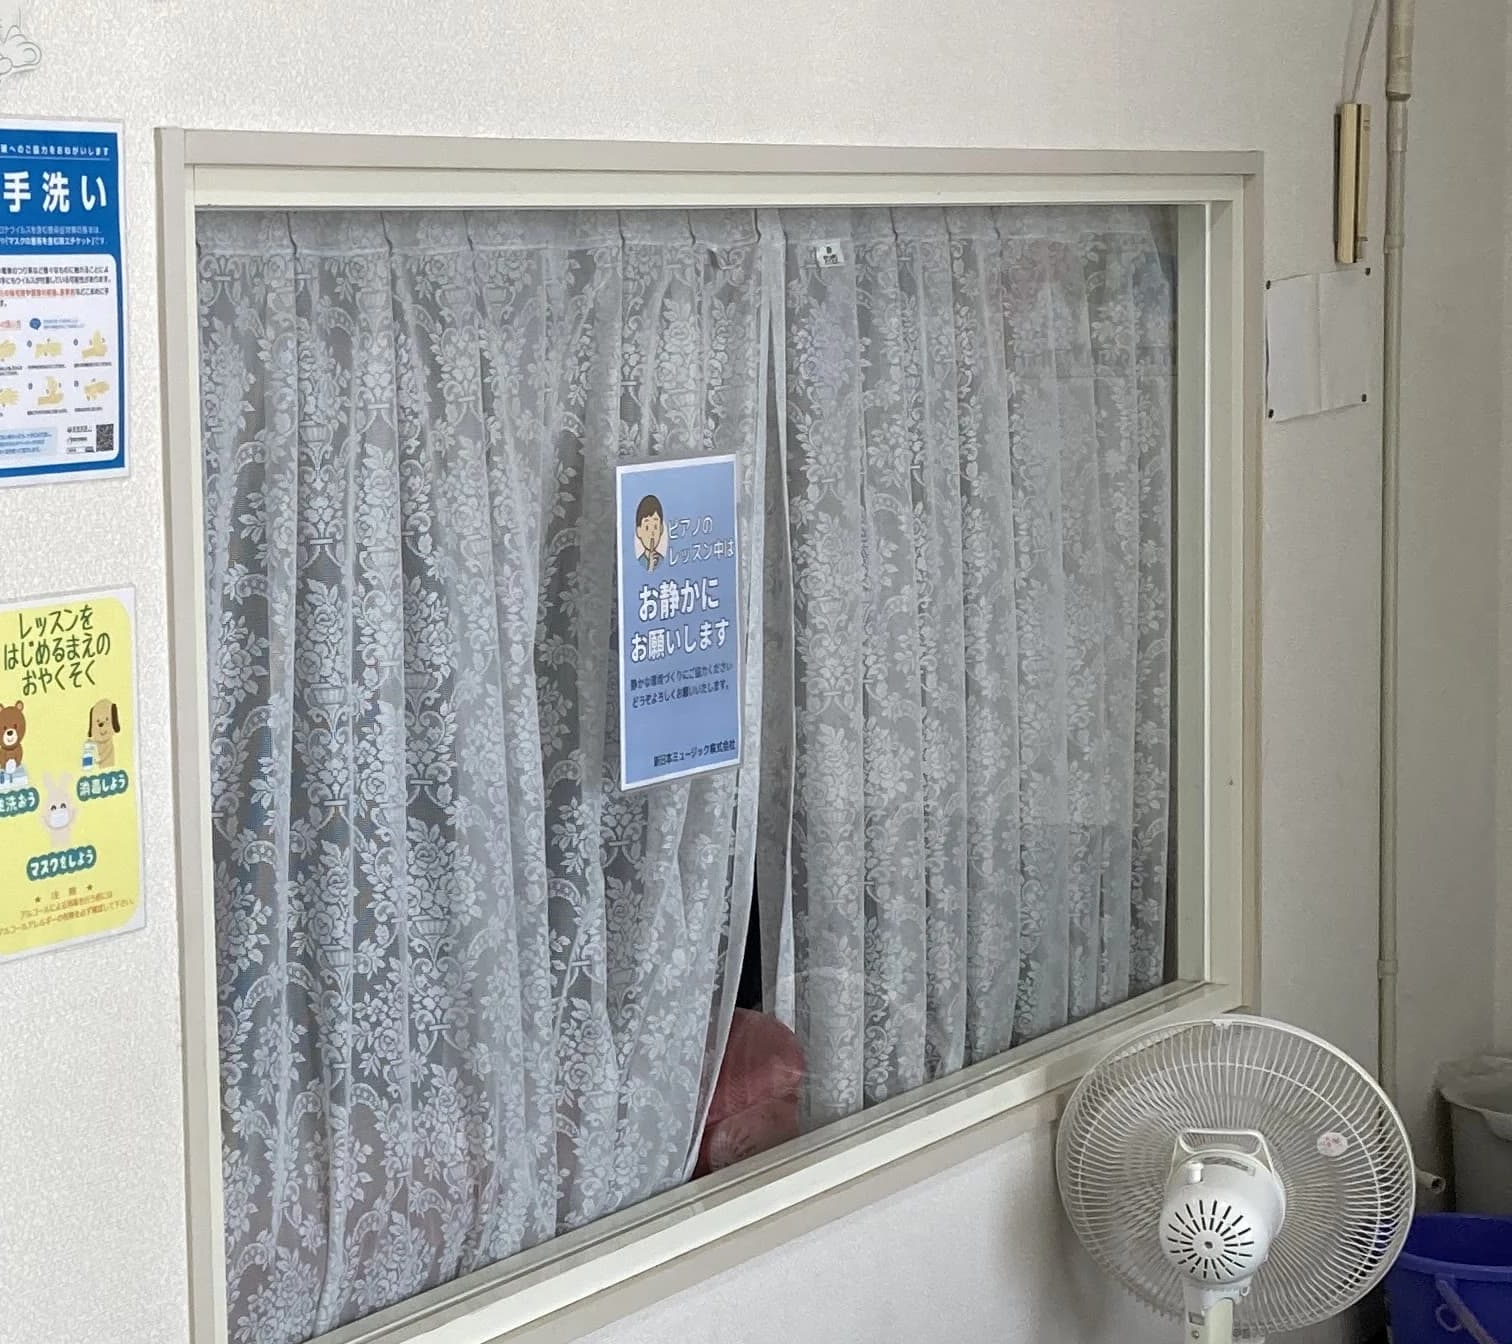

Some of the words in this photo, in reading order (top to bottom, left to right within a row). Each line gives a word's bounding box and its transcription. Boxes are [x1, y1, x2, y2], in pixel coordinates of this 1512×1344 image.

[3, 170, 108, 213] 手洗い
[669, 517, 713, 540] ピアノの
[669, 538, 735, 566] レッスン中は
[639, 577, 719, 622] お静かに
[18, 605, 94, 639] レッスンを
[4, 632, 111, 671] はじめるまえの
[631, 618, 730, 663] お願いします
[22, 659, 96, 696] おやくそく
[79, 775, 126, 797] 消毒しよう
[30, 849, 95, 877] マスクをしよう
